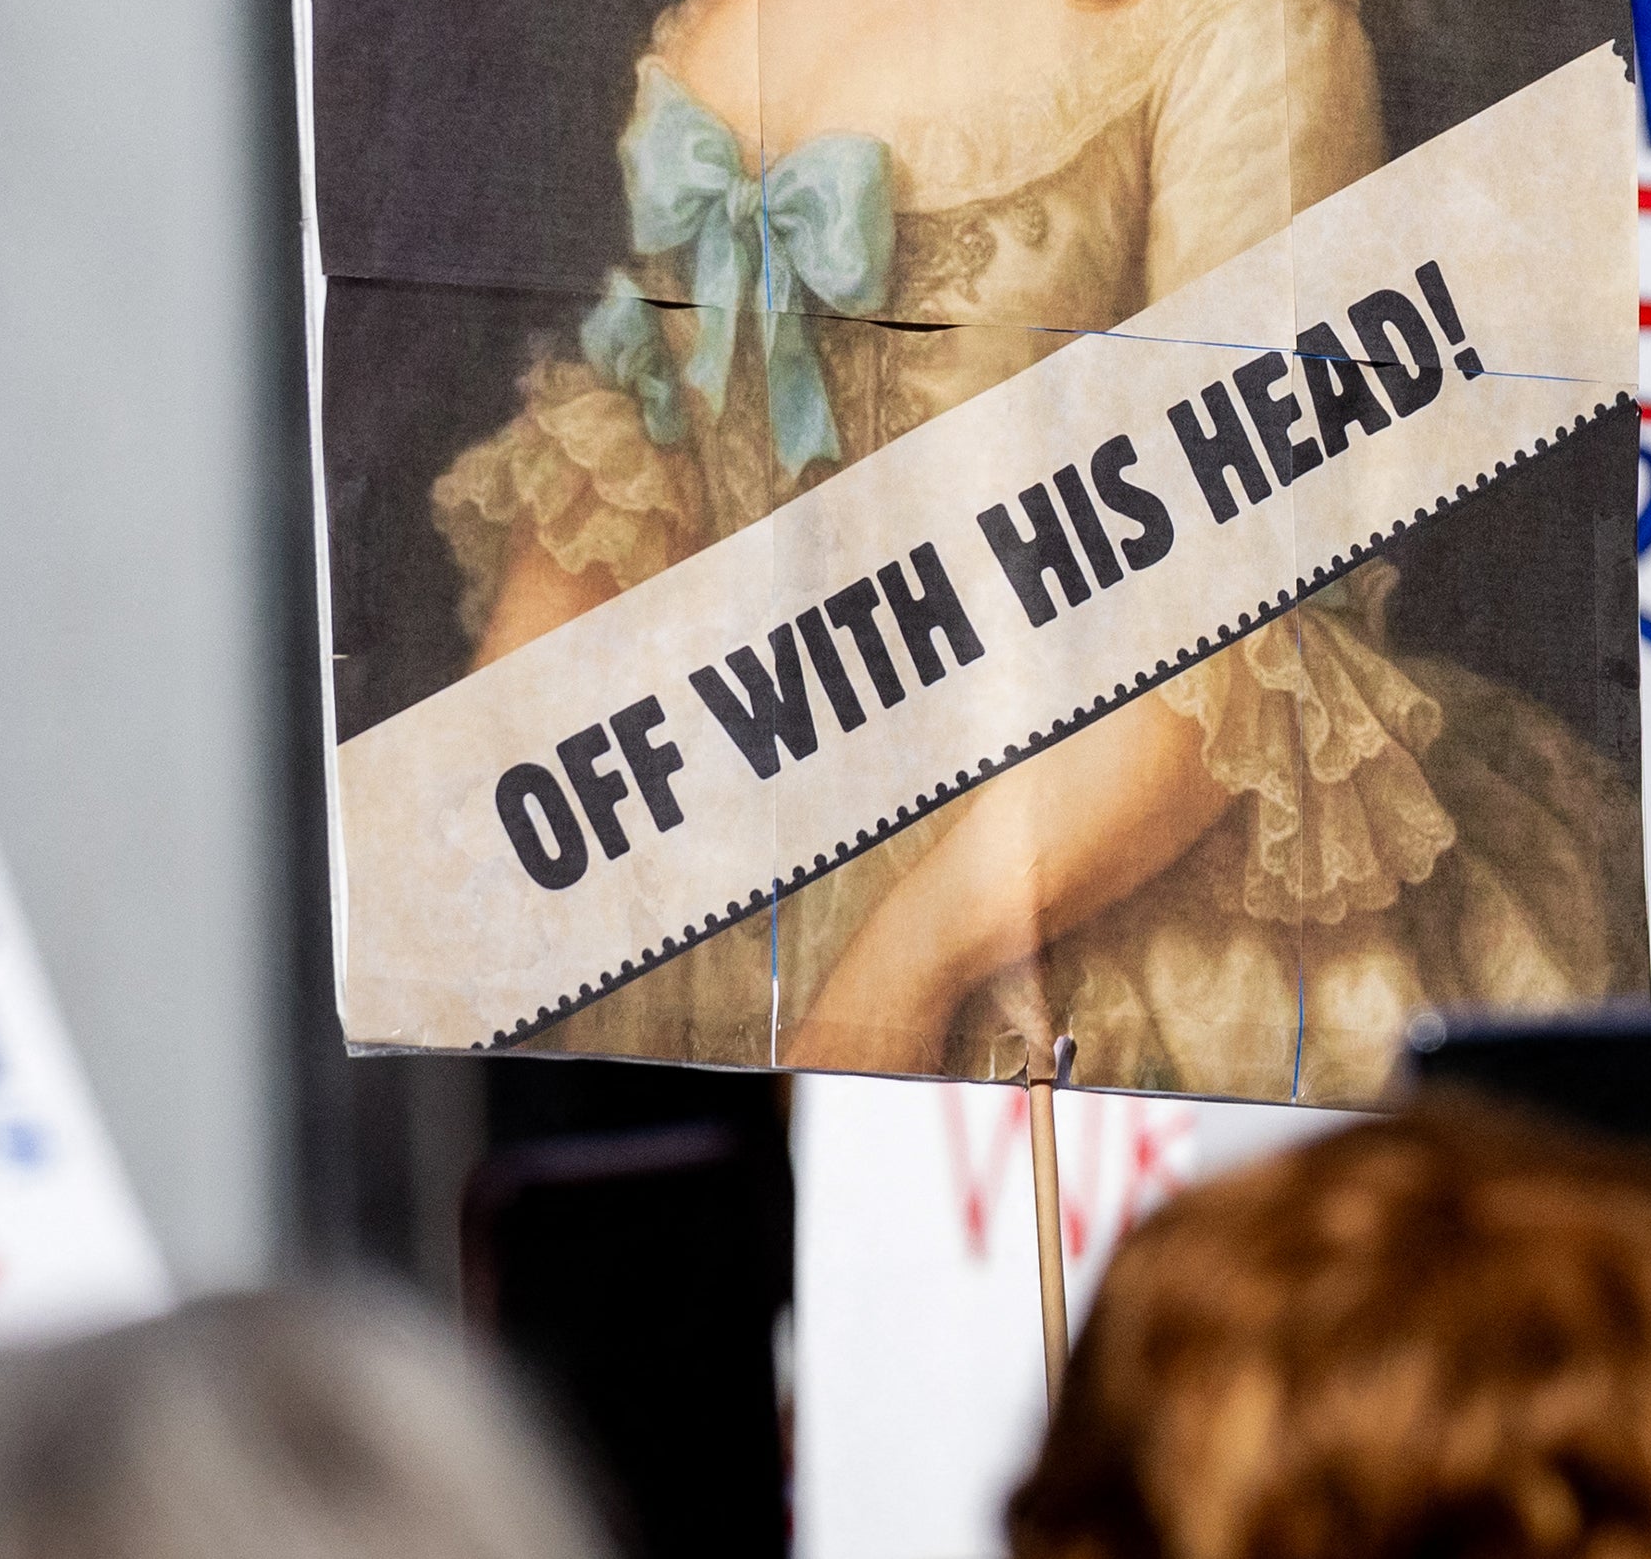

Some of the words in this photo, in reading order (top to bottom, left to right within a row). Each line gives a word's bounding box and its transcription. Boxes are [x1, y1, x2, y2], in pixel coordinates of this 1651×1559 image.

[495, 695, 684, 891] OFF
[688, 542, 985, 780] WITH
[976, 433, 1175, 628] HIS
[1166, 259, 1484, 525] HEAD!
